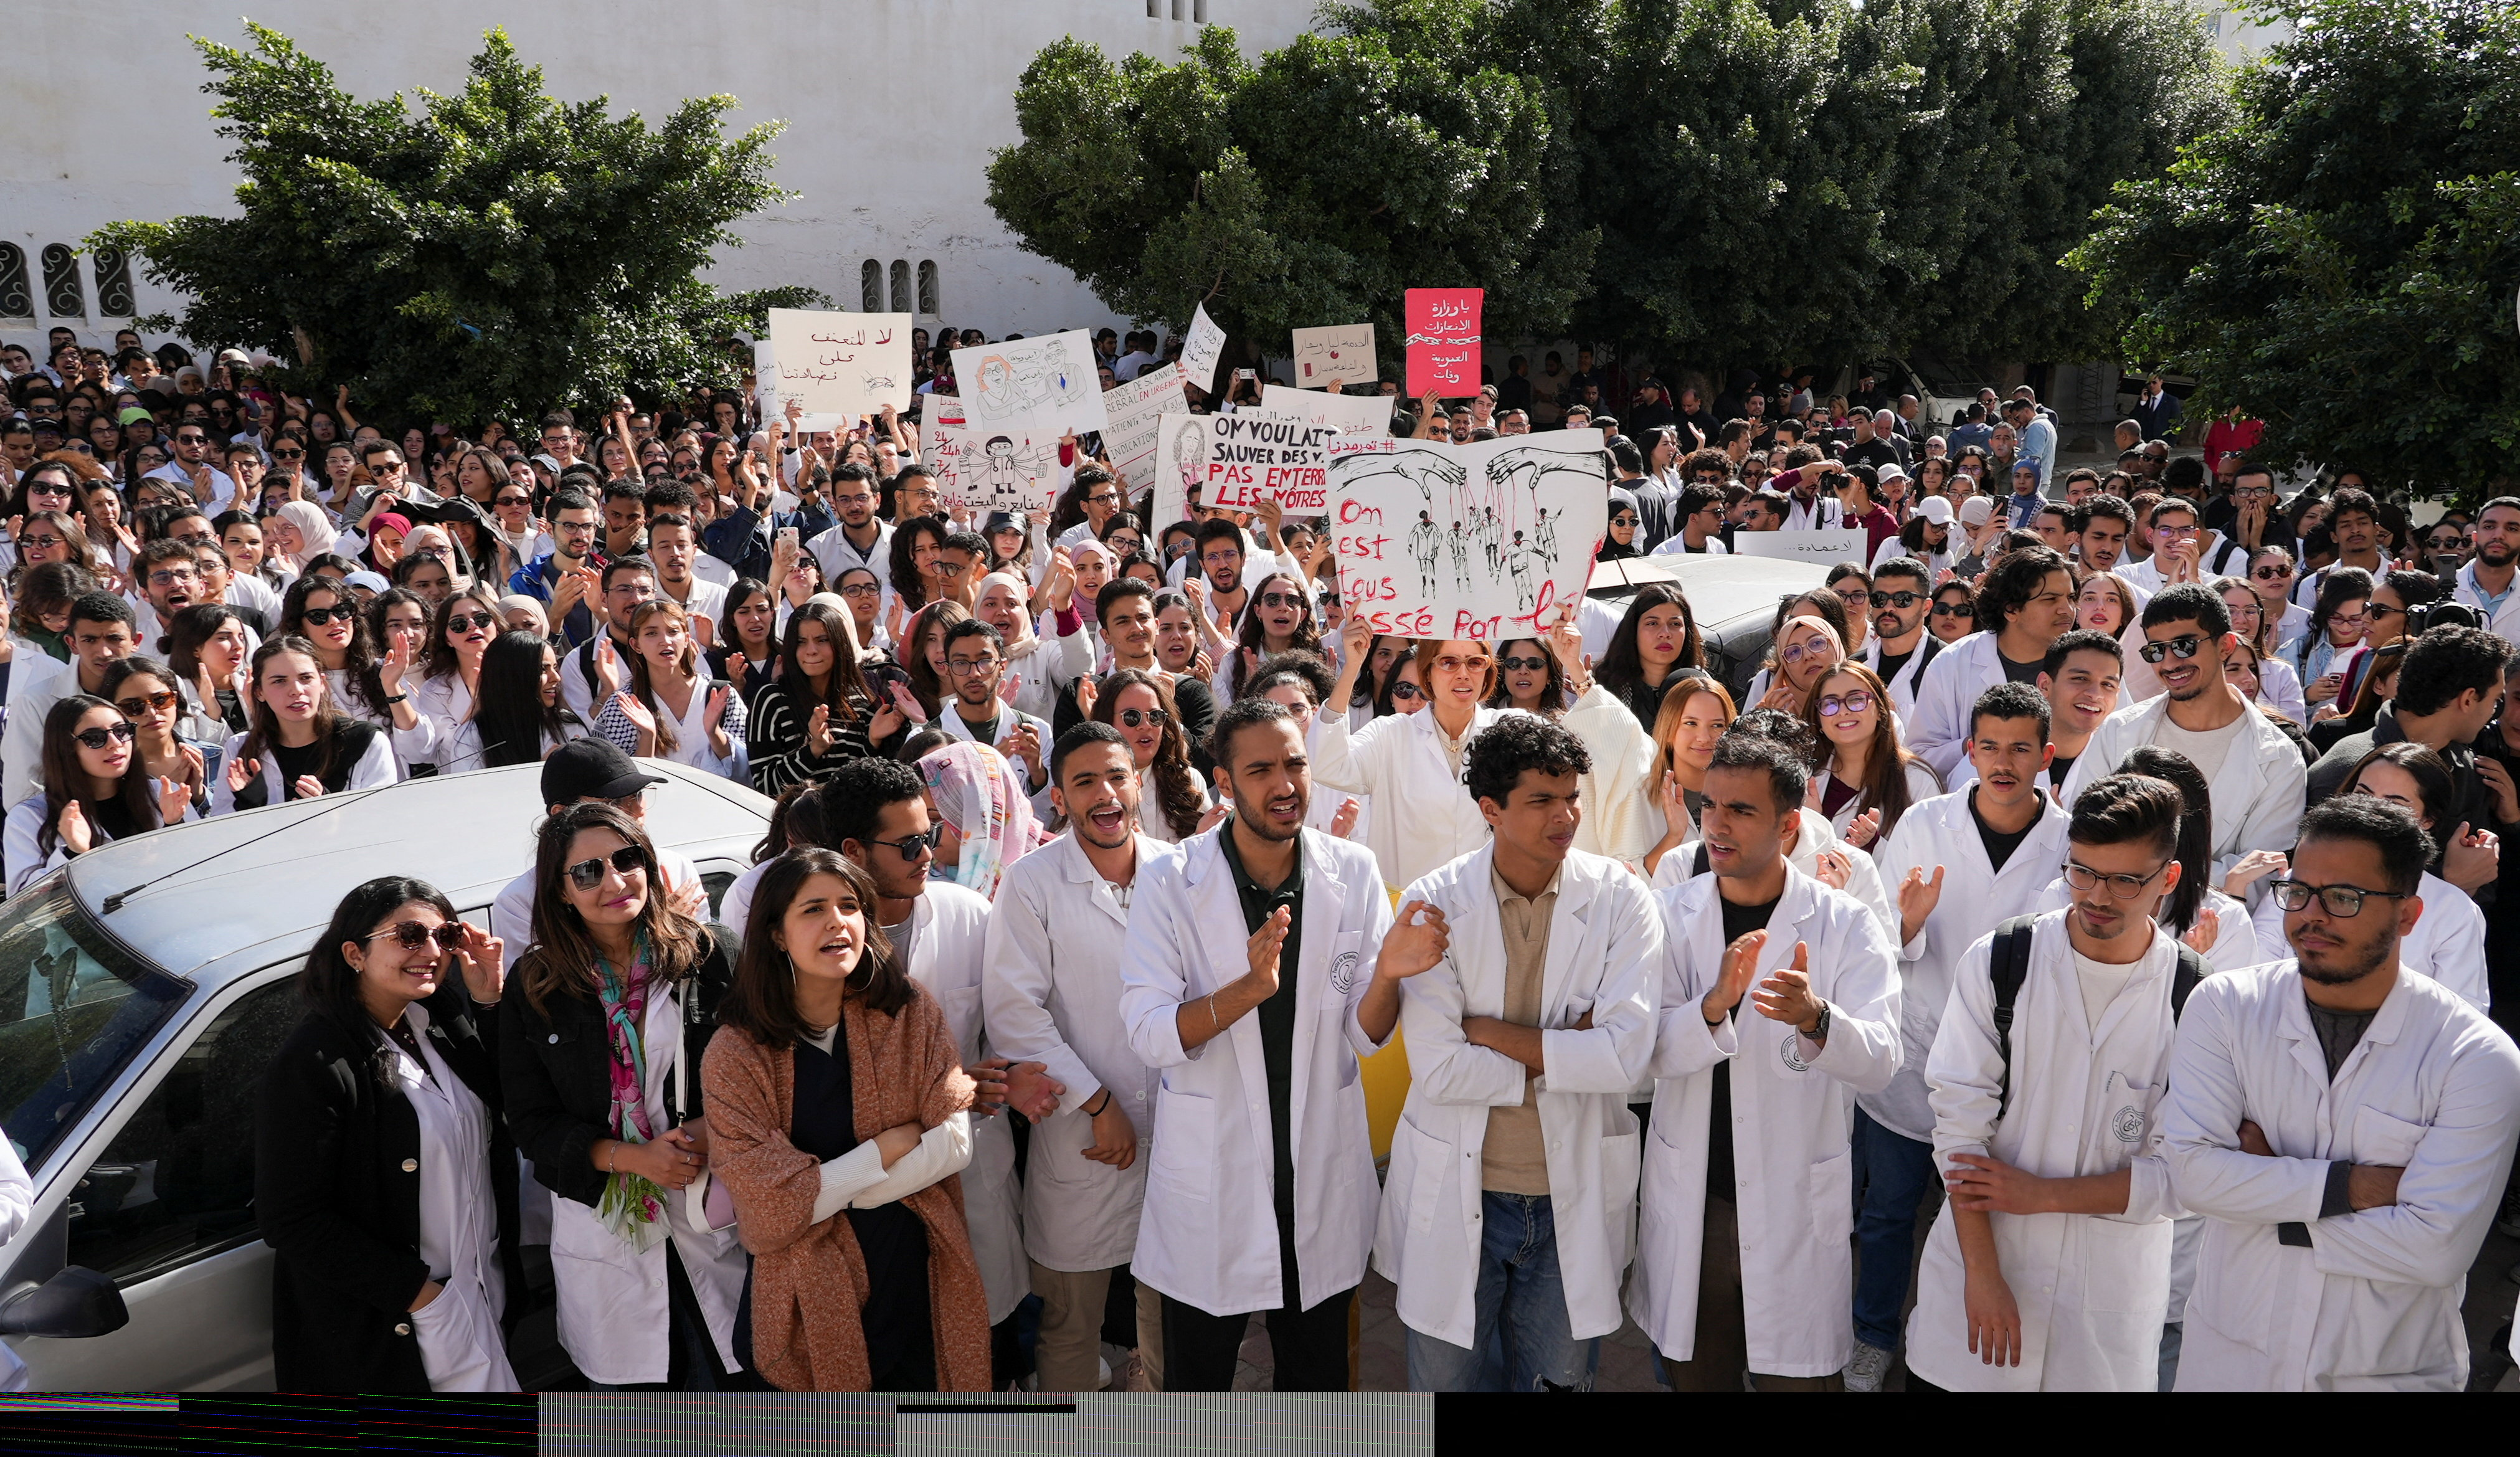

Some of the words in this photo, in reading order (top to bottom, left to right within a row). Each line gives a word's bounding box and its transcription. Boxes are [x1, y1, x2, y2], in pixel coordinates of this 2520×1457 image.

[1433, 300, 1459, 317] وزارة
[1461, 299, 1470, 313] يا
[875, 328, 891, 344] لا
[819, 351, 855, 365] على
[1431, 351, 1468, 367] العبودية
[778, 361, 837, 386] نضالاتنا
[1134, 381, 1142, 392] DE
[1145, 366, 1176, 387] SCANNER
[1433, 369, 1460, 383] وفات
[1139, 391, 1149, 401] EN
[1152, 377, 1180, 395] URGENCE
[1215, 417, 1246, 439] ON
[1248, 420, 1337, 447] VOULAIT
[1212, 443, 1274, 464] SAUVER
[1282, 450, 1308, 465] DES
[1208, 463, 1253, 484] PAS
[1216, 485, 1262, 506] LES
[1336, 498, 1384, 526] On
[1338, 534, 1394, 561] est
[1337, 564, 1398, 602] tous
